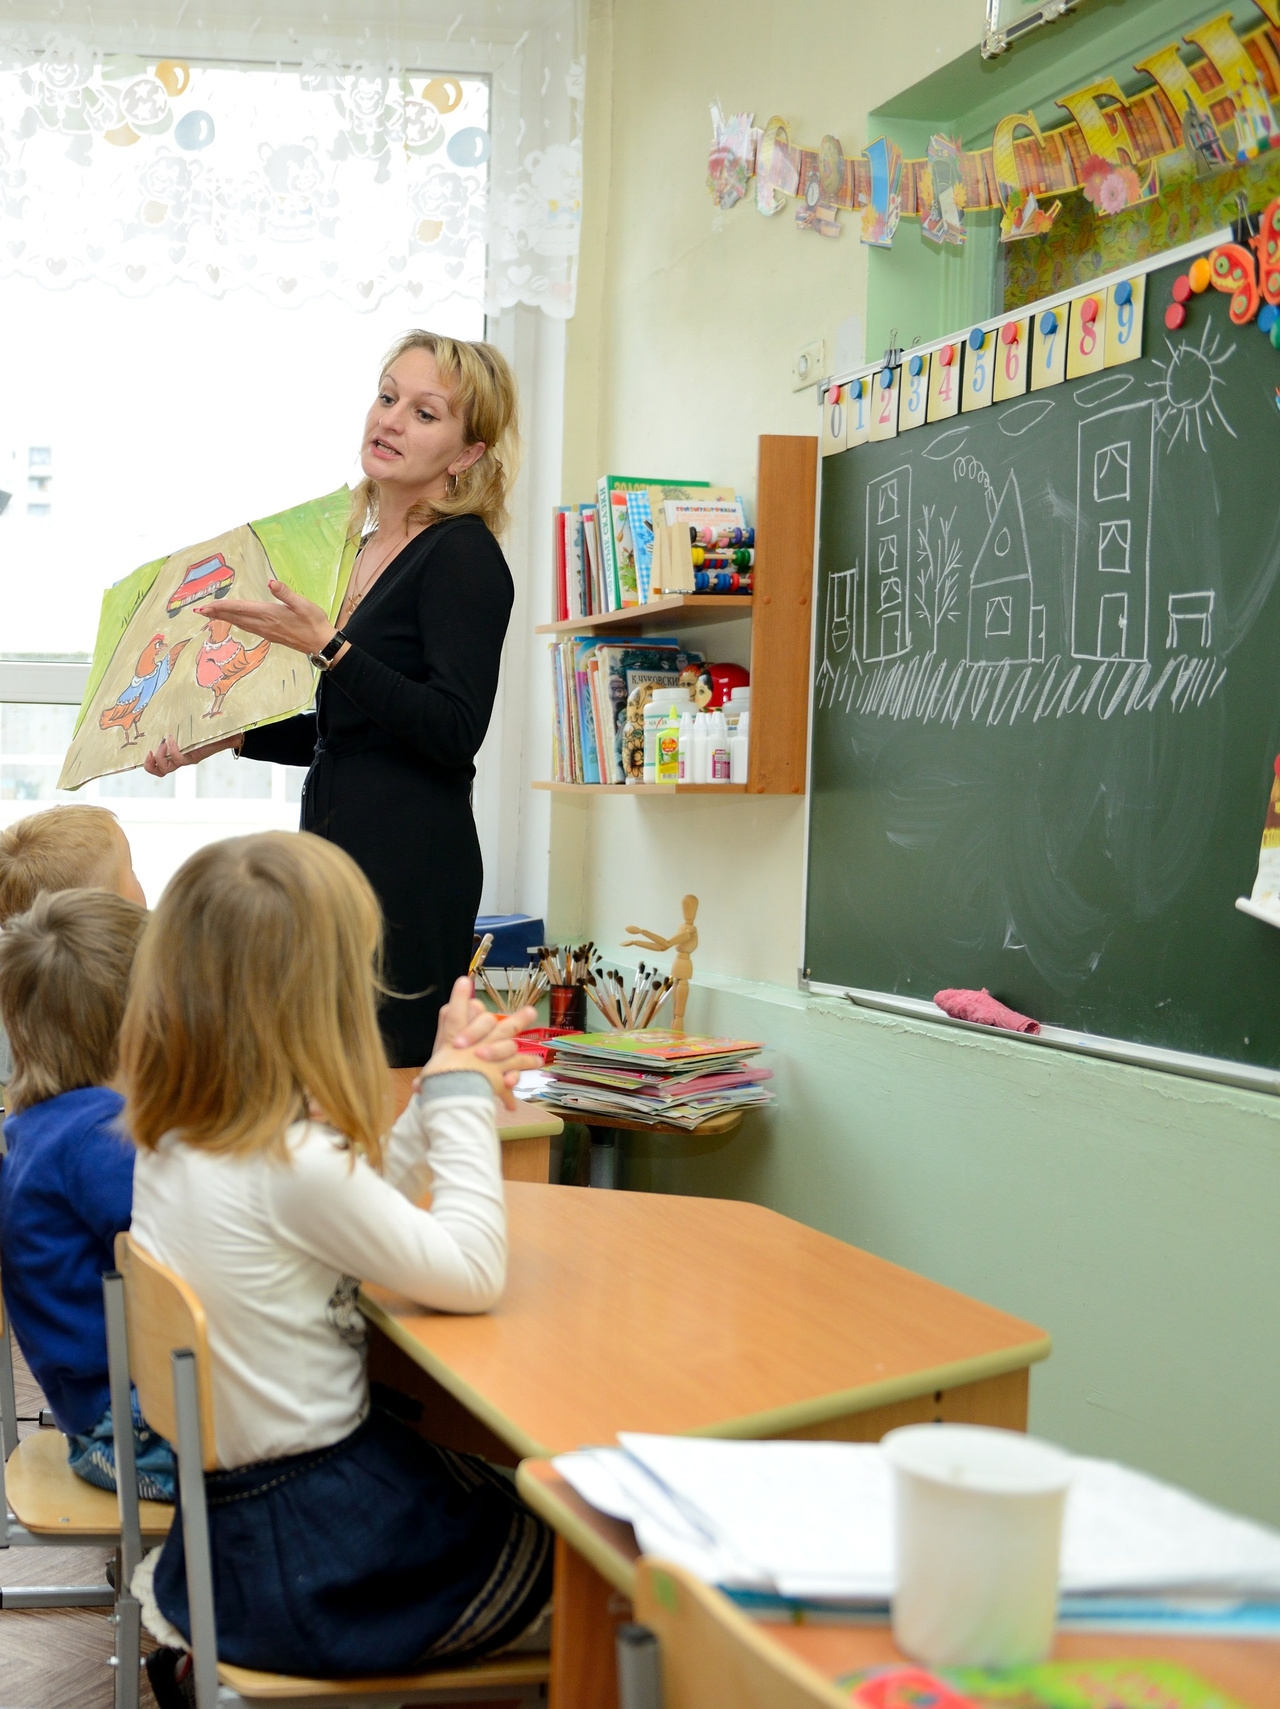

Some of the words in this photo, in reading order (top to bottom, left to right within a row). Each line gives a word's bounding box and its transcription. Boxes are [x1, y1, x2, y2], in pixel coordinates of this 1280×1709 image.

[831, 402, 842, 438] 0
[855, 397, 865, 430] 1
[878, 387, 892, 424] 2
[907, 374, 921, 412] 3
[938, 364, 952, 402] 4
[972, 349, 986, 392] 5
[1005, 337, 1020, 381] 6
[1042, 322, 1059, 369] 7
[1079, 319, 1097, 356] 8
[1117, 298, 1134, 345] 9
[599, 486, 609, 535] СКАЗКИ
[603, 536, 614, 597] ЗОЛОТЫЕ
